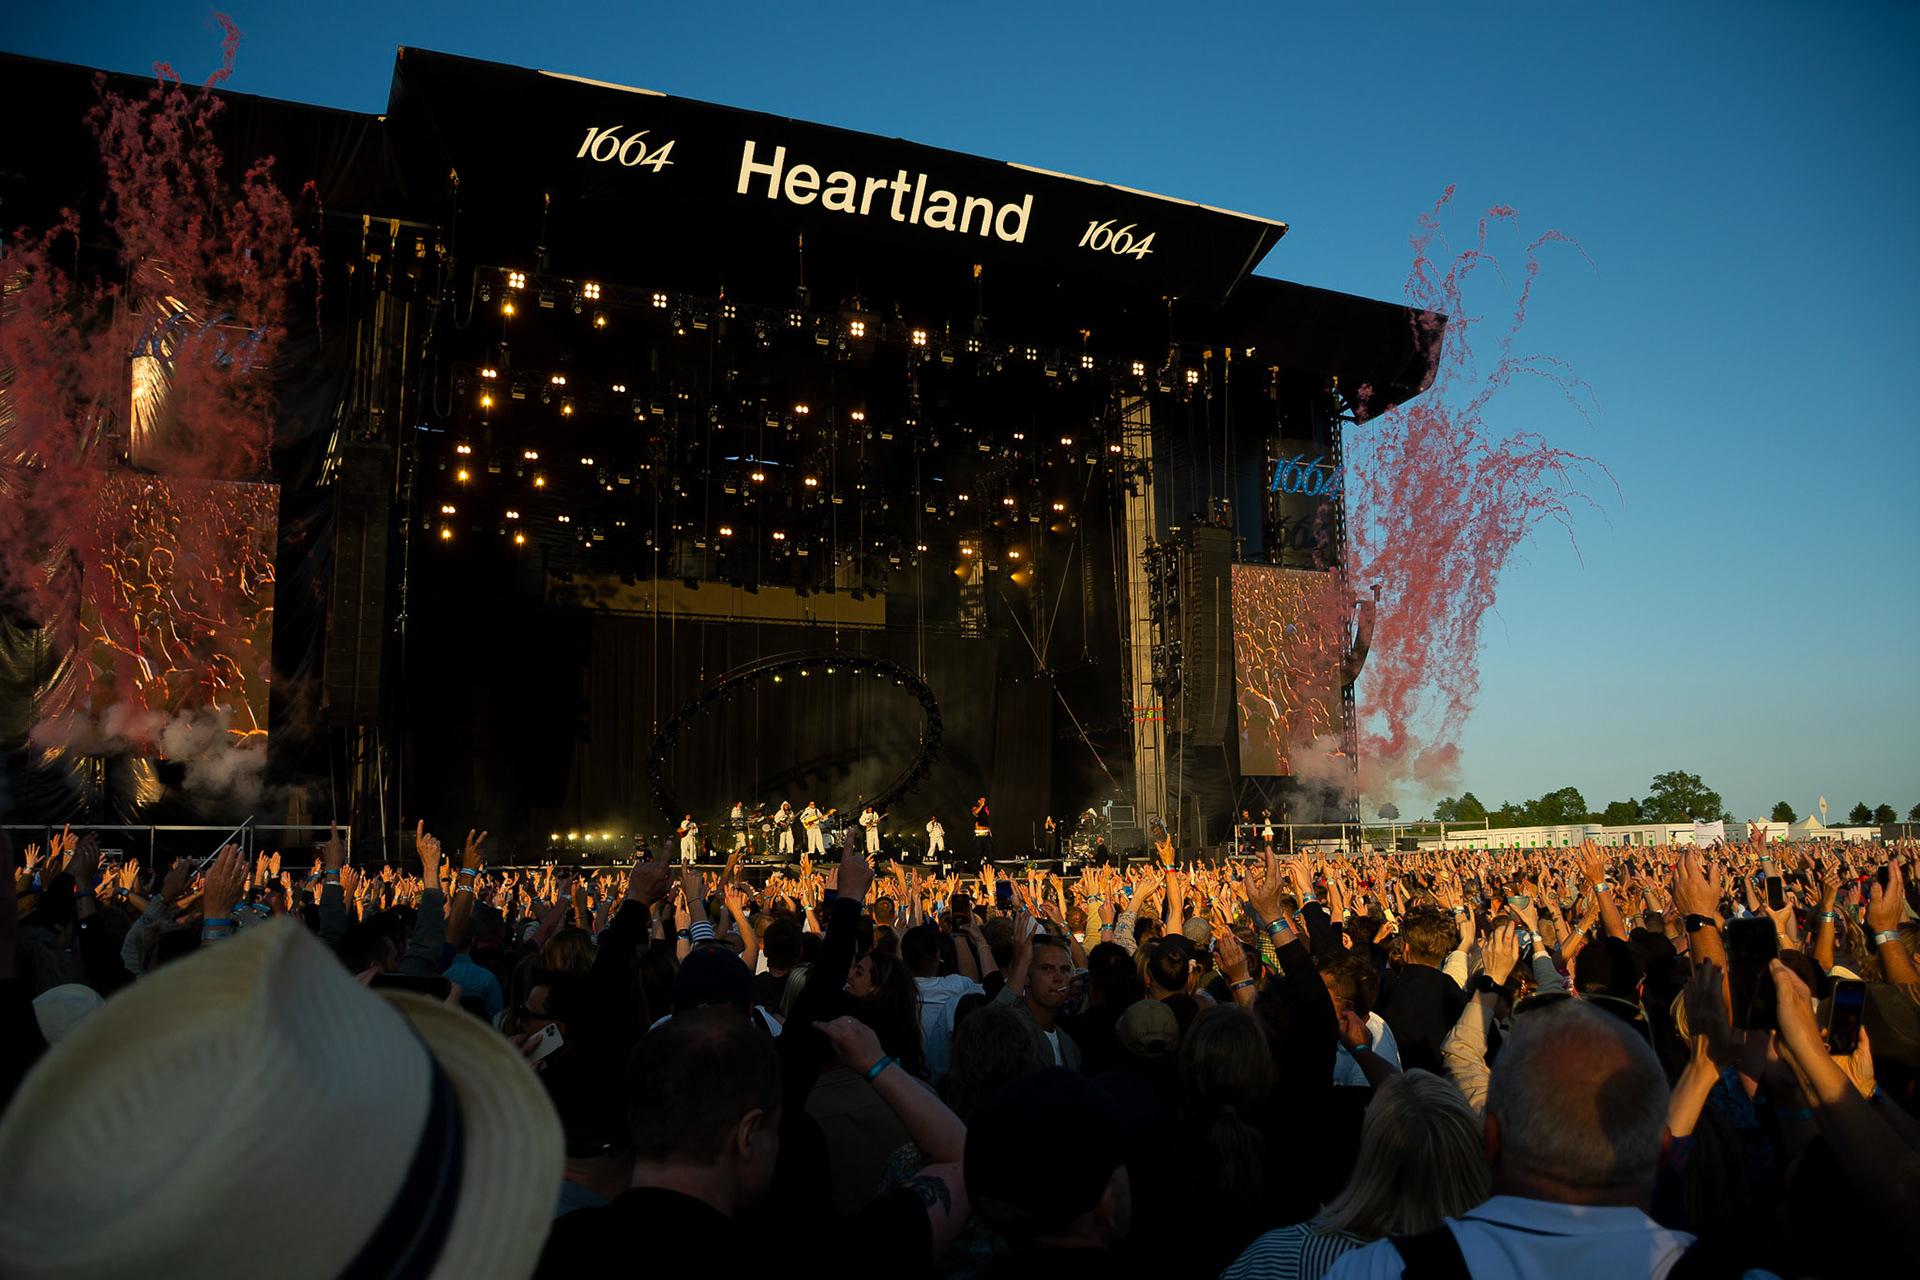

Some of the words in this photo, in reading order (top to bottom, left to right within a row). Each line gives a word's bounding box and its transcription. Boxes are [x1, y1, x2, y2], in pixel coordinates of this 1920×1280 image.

[577, 126, 675, 172] 1664
[737, 140, 1033, 243] Heartland
[1078, 219, 1156, 260] 1664
[1270, 453, 1344, 501] 1664
